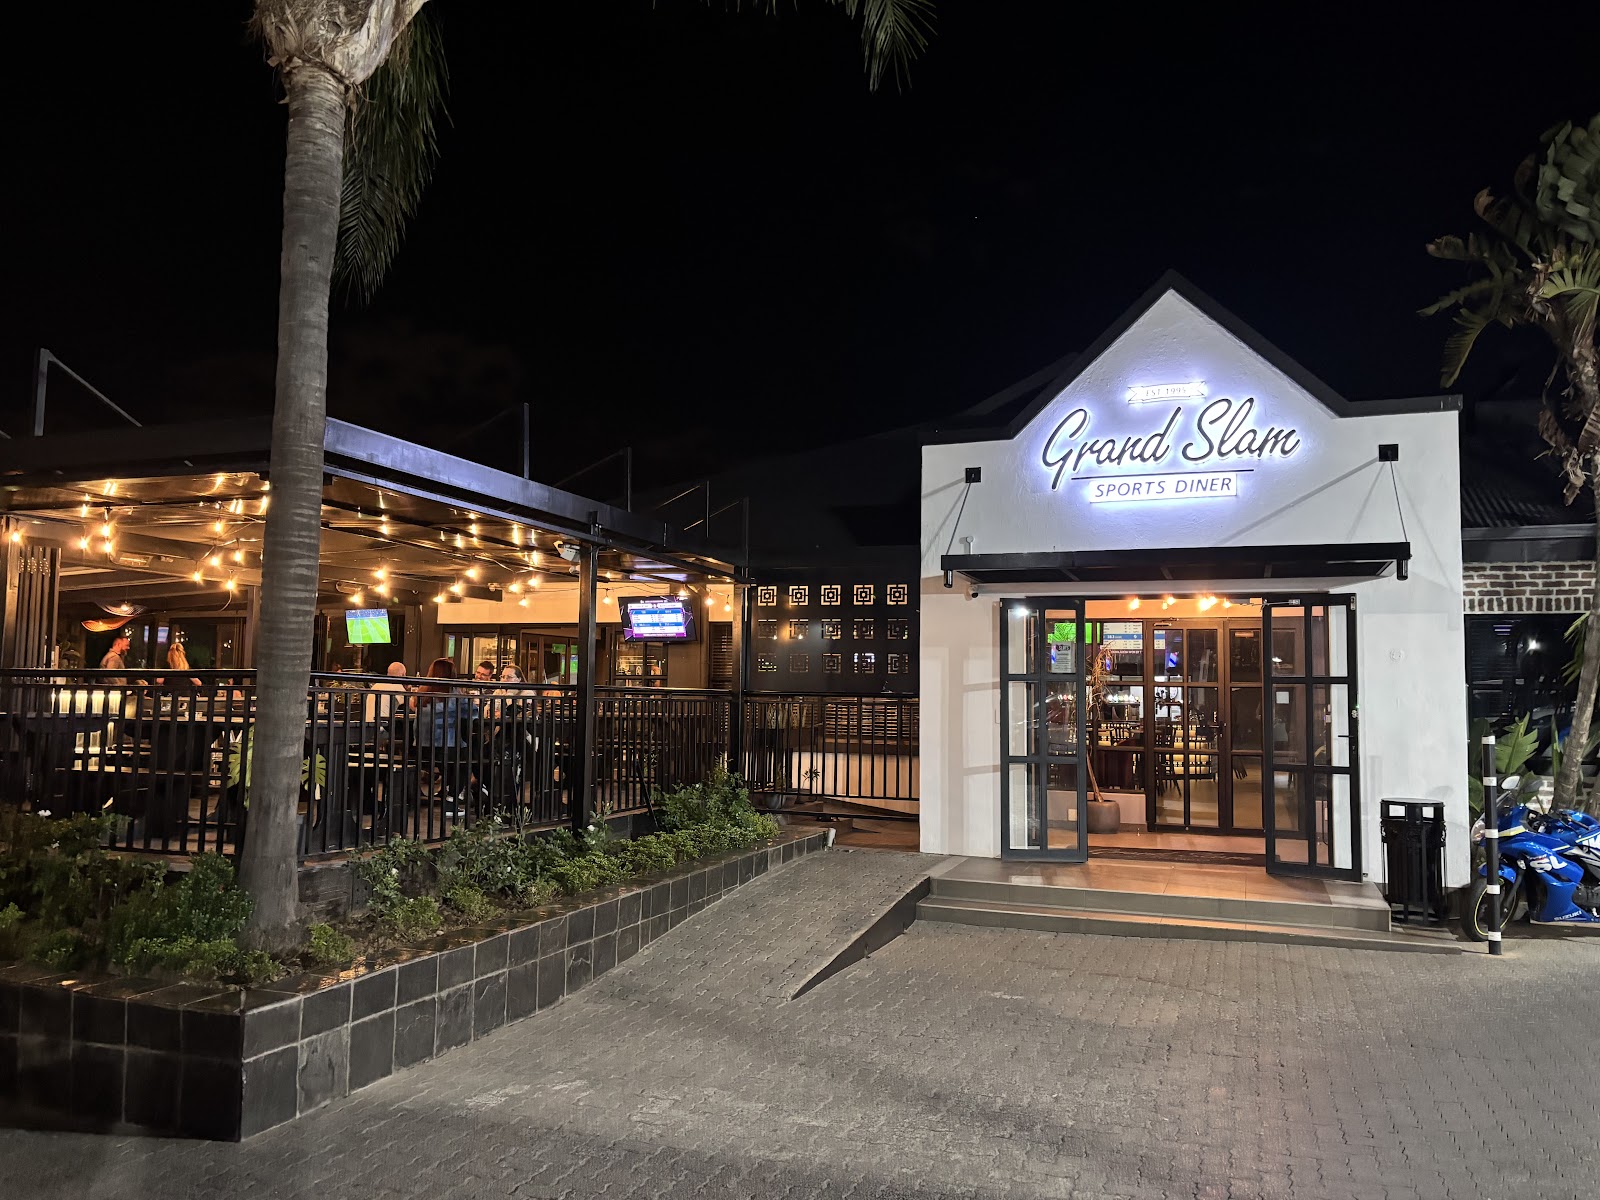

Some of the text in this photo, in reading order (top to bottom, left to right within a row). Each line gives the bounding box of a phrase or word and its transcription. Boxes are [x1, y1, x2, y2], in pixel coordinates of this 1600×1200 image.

[1042, 397, 1301, 490] Grand Slam
[1095, 477, 1233, 498] SPORTS DINER
